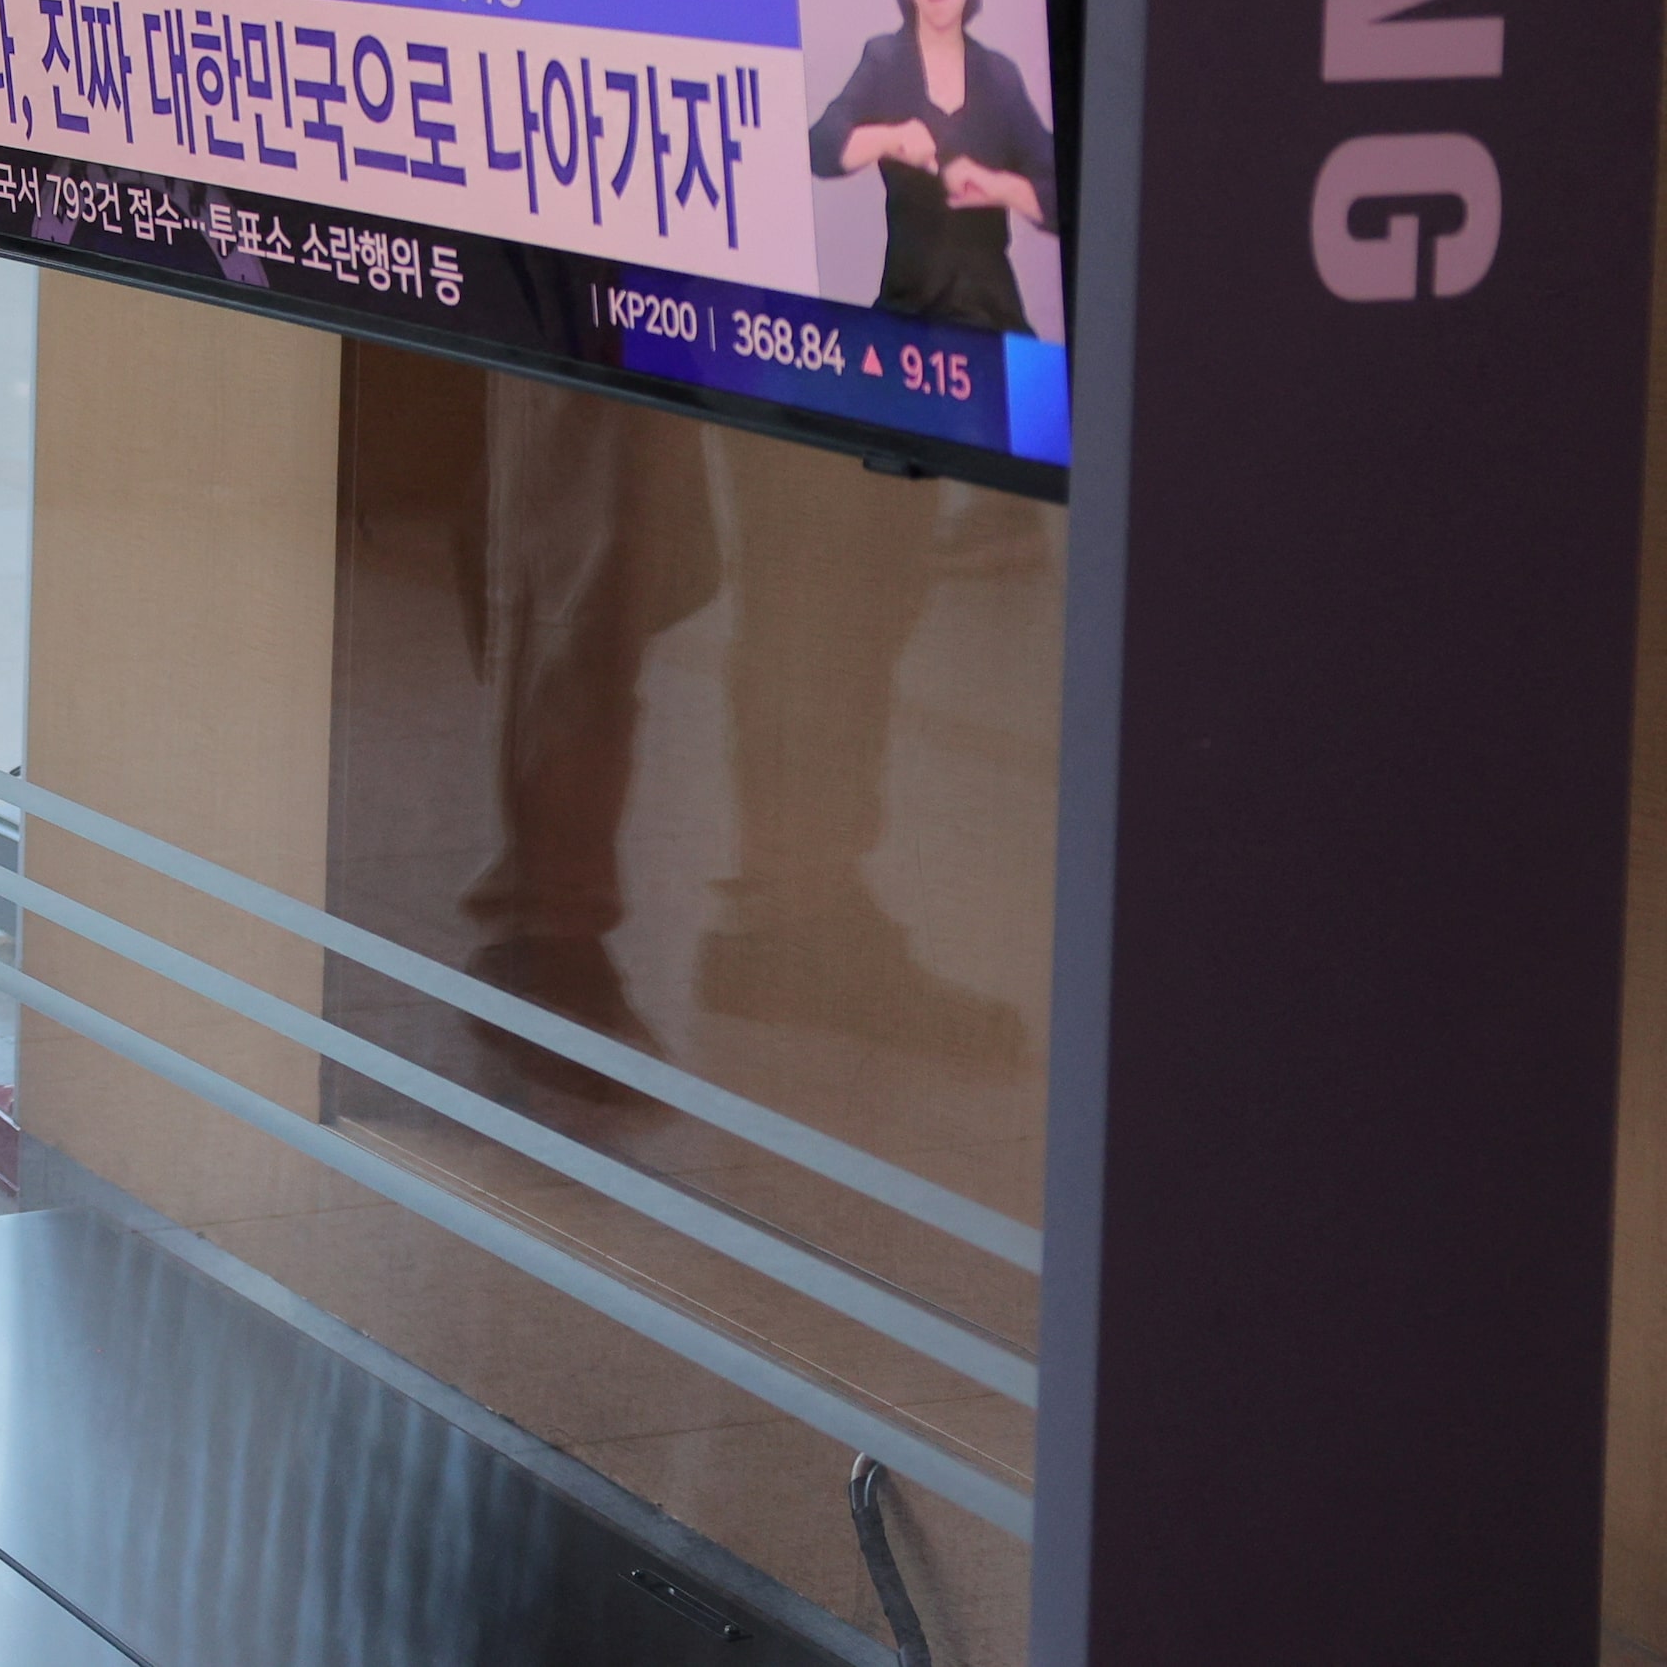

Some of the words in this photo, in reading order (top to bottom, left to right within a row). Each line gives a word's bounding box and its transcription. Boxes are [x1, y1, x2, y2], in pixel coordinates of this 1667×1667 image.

[142, 7, 467, 187] 대한민국으로
[478, 48, 761, 250] 나아가자"
[45, 172, 122, 235] 793건
[301, 222, 424, 300] 소란행위
[429, 246, 465, 308] 등
[607, 286, 698, 343] KP200
[730, 309, 847, 377] 368.84
[899, 343, 973, 402] 9.15
